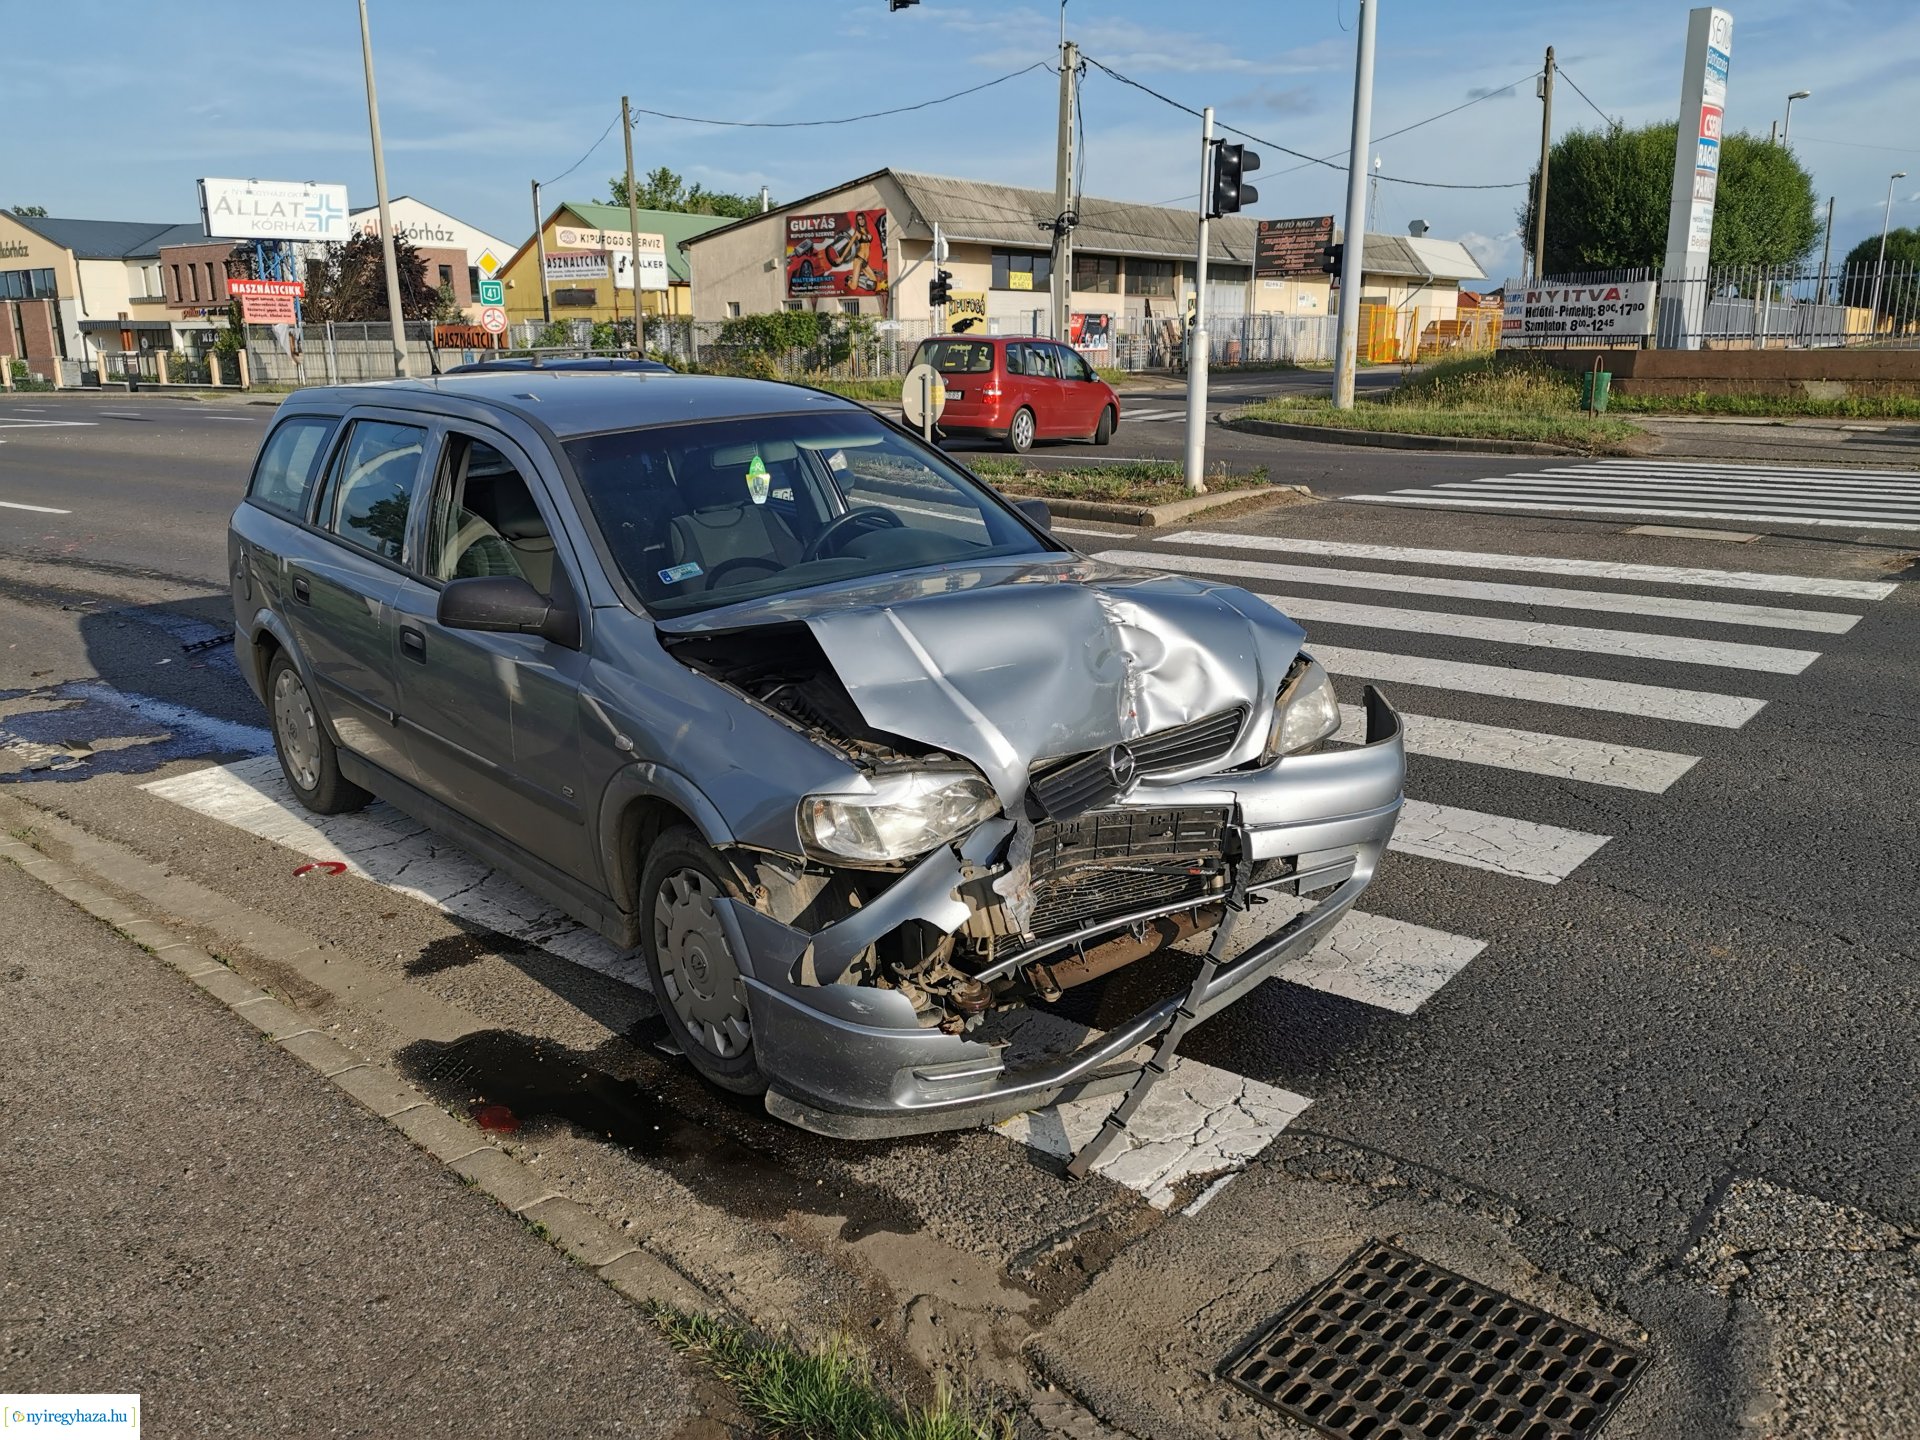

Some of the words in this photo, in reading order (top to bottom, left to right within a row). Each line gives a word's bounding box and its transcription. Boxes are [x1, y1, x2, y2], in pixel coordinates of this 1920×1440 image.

[213, 190, 304, 217] ÁLLAT
[251, 217, 316, 232] KÓRHÁZ
[790, 216, 836, 231] GULYÁS
[580, 234, 624, 246] KIPUFOGÓ
[626, 237, 661, 249] SERVIZ
[547, 253, 606, 269] ASZNÁLTCIKK
[231, 282, 302, 295] HASZNÁLTCIKK
[487, 288, 497, 298] 41
